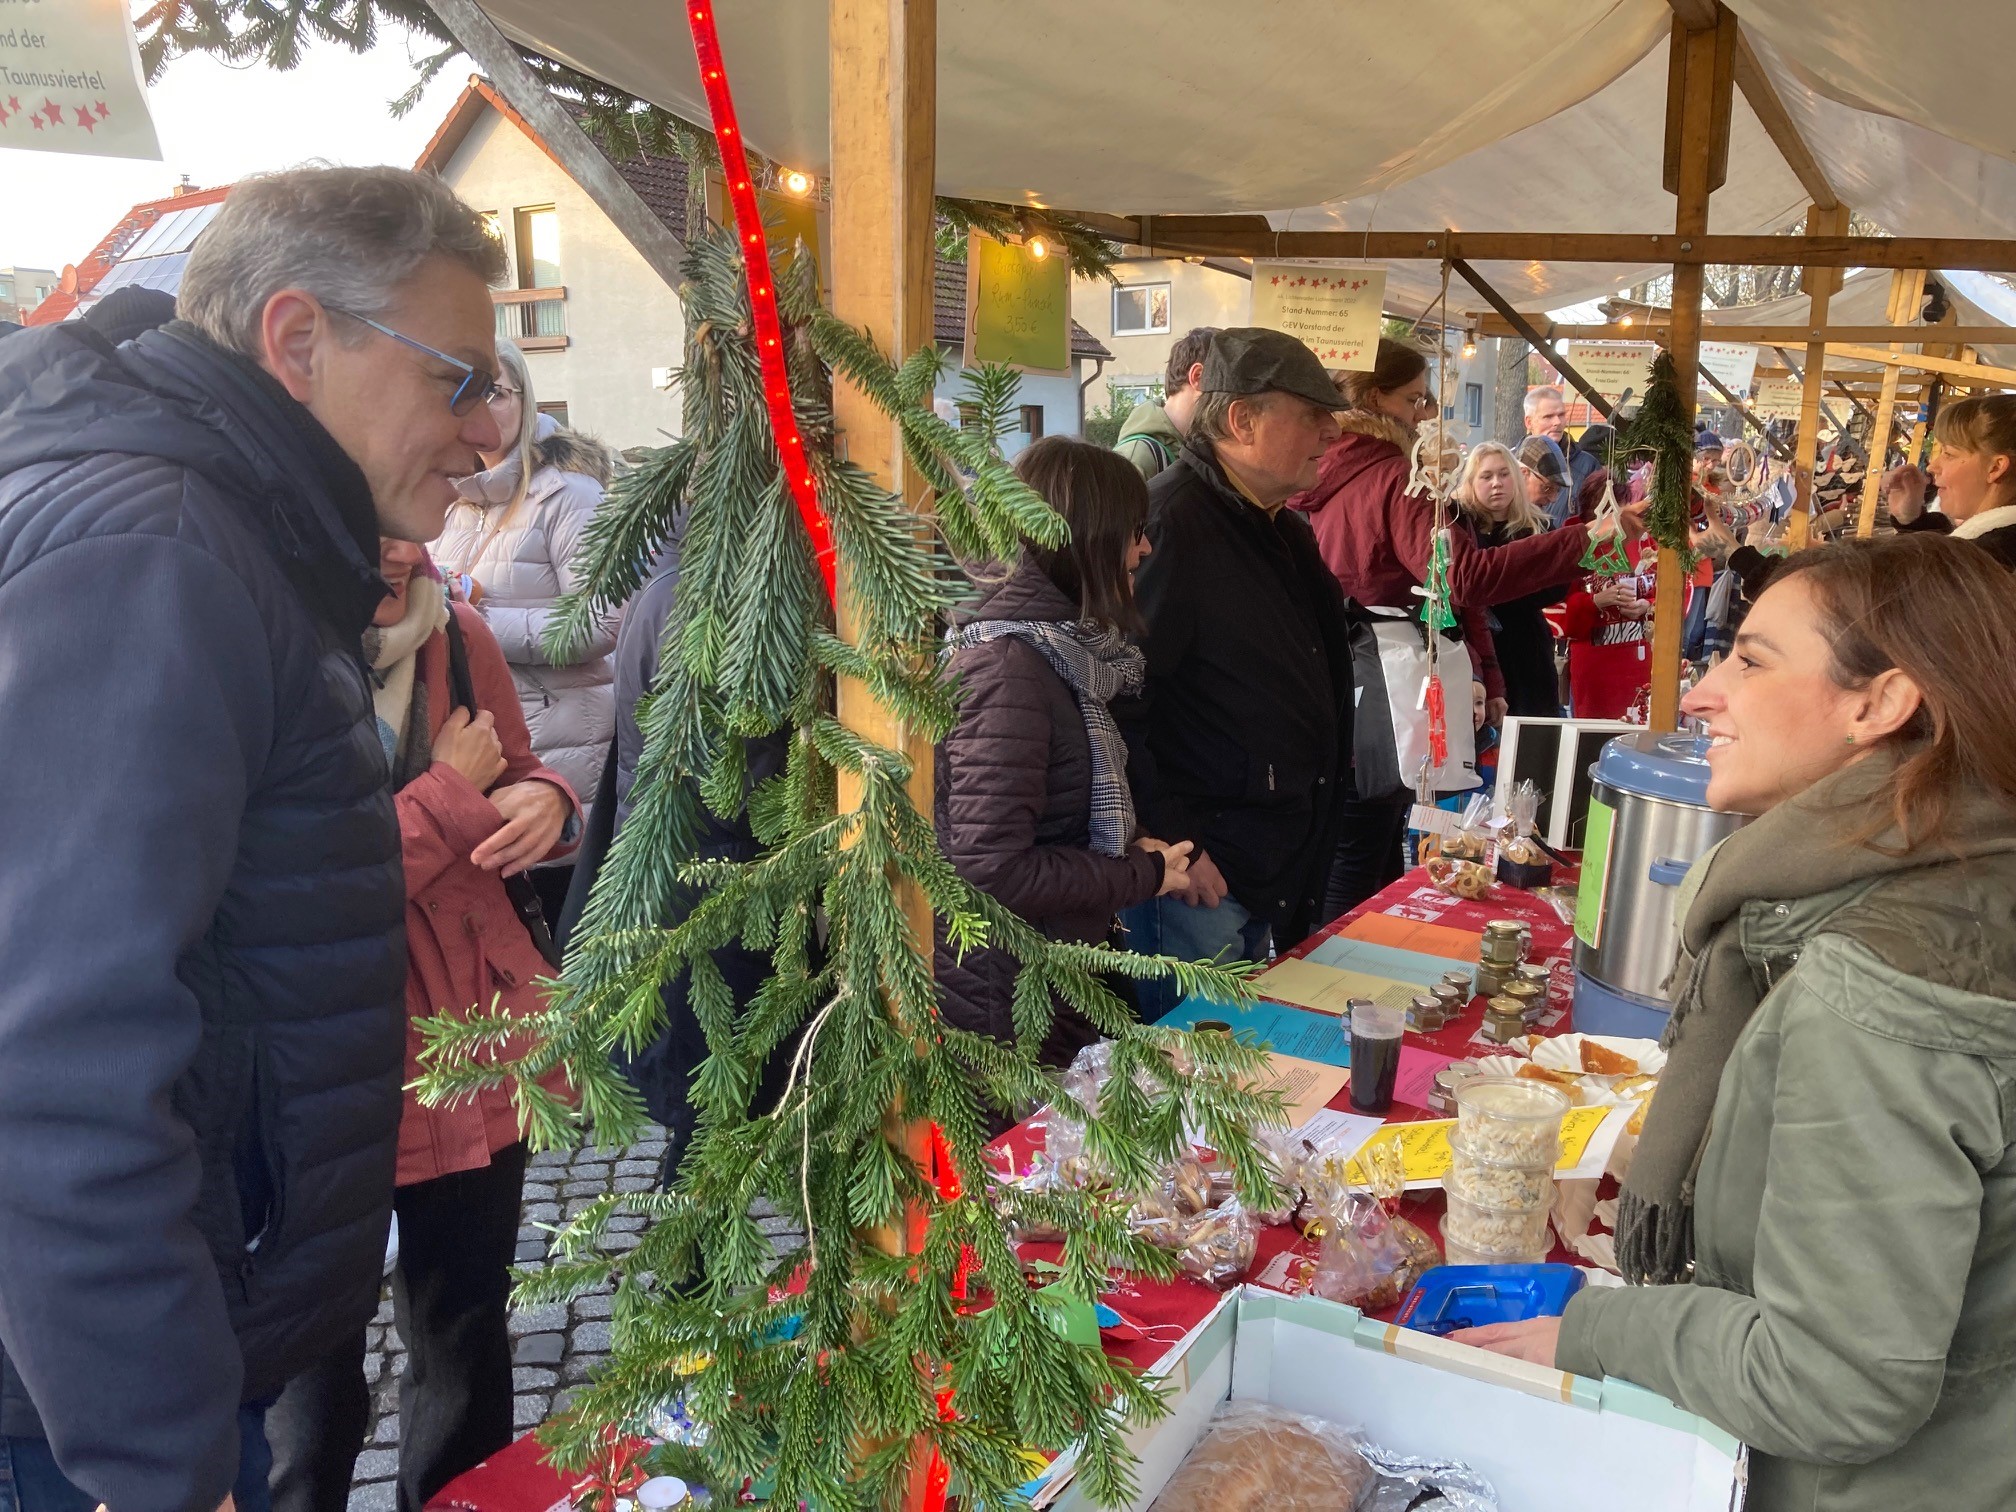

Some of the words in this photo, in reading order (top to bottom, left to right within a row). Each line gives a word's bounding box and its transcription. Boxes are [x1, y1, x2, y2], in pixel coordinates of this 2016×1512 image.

[20, 28, 46, 48] der
[0, 66, 106, 90] Taunusviertel
[1281, 305, 1338, 317] Stand-Nummer:
[1339, 309, 1349, 318] 65
[1282, 320, 1298, 329] GEV
[1299, 322, 1332, 332] Vorstand
[1332, 324, 1345, 333] der
[1306, 335, 1316, 343] im
[1316, 336, 1364, 348] Taunusviertel
